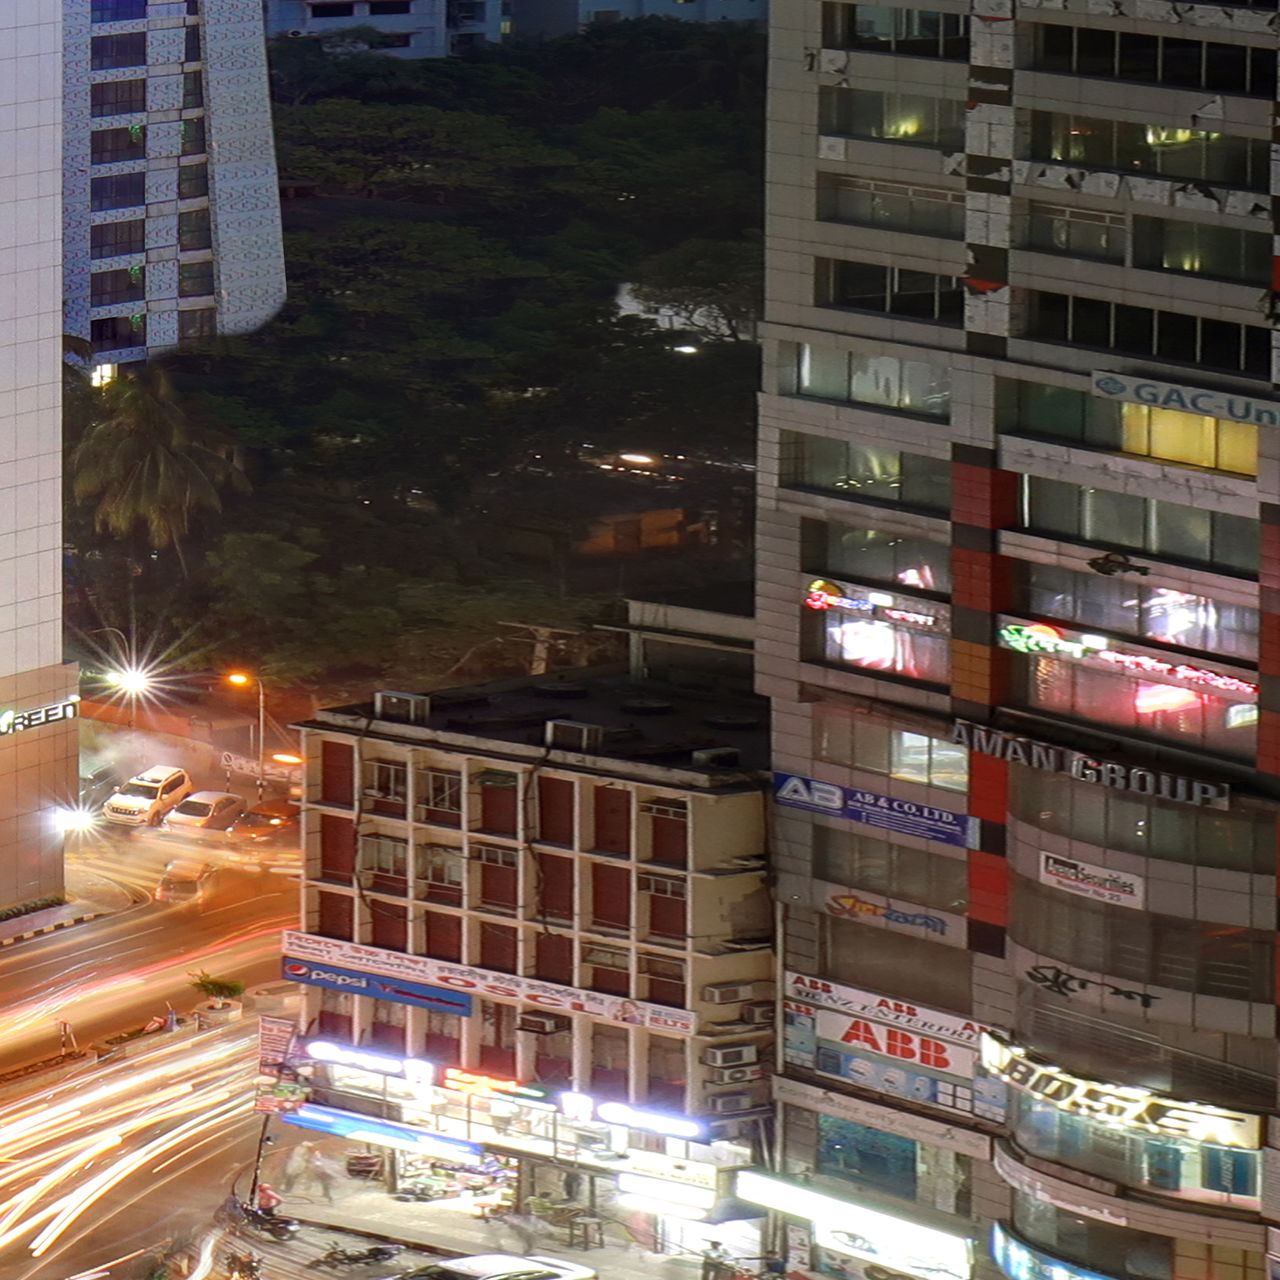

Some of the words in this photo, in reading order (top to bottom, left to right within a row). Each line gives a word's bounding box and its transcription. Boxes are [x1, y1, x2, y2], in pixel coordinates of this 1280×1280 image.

[951, 718, 1056, 771] AMAN
[1070, 752, 1221, 807] GROUP
[776, 776, 844, 810] AB
[853, 793, 875, 804] AB
[876, 797, 889, 808] &
[893, 801, 920, 815] CO.
[922, 806, 957, 824] LTD.
[311, 969, 368, 988] pepsi
[792, 975, 833, 994] ABB
[860, 1003, 977, 1042] ENTERPRI
[876, 998, 918, 1017] ABB
[841, 1019, 950, 1069] ABB
